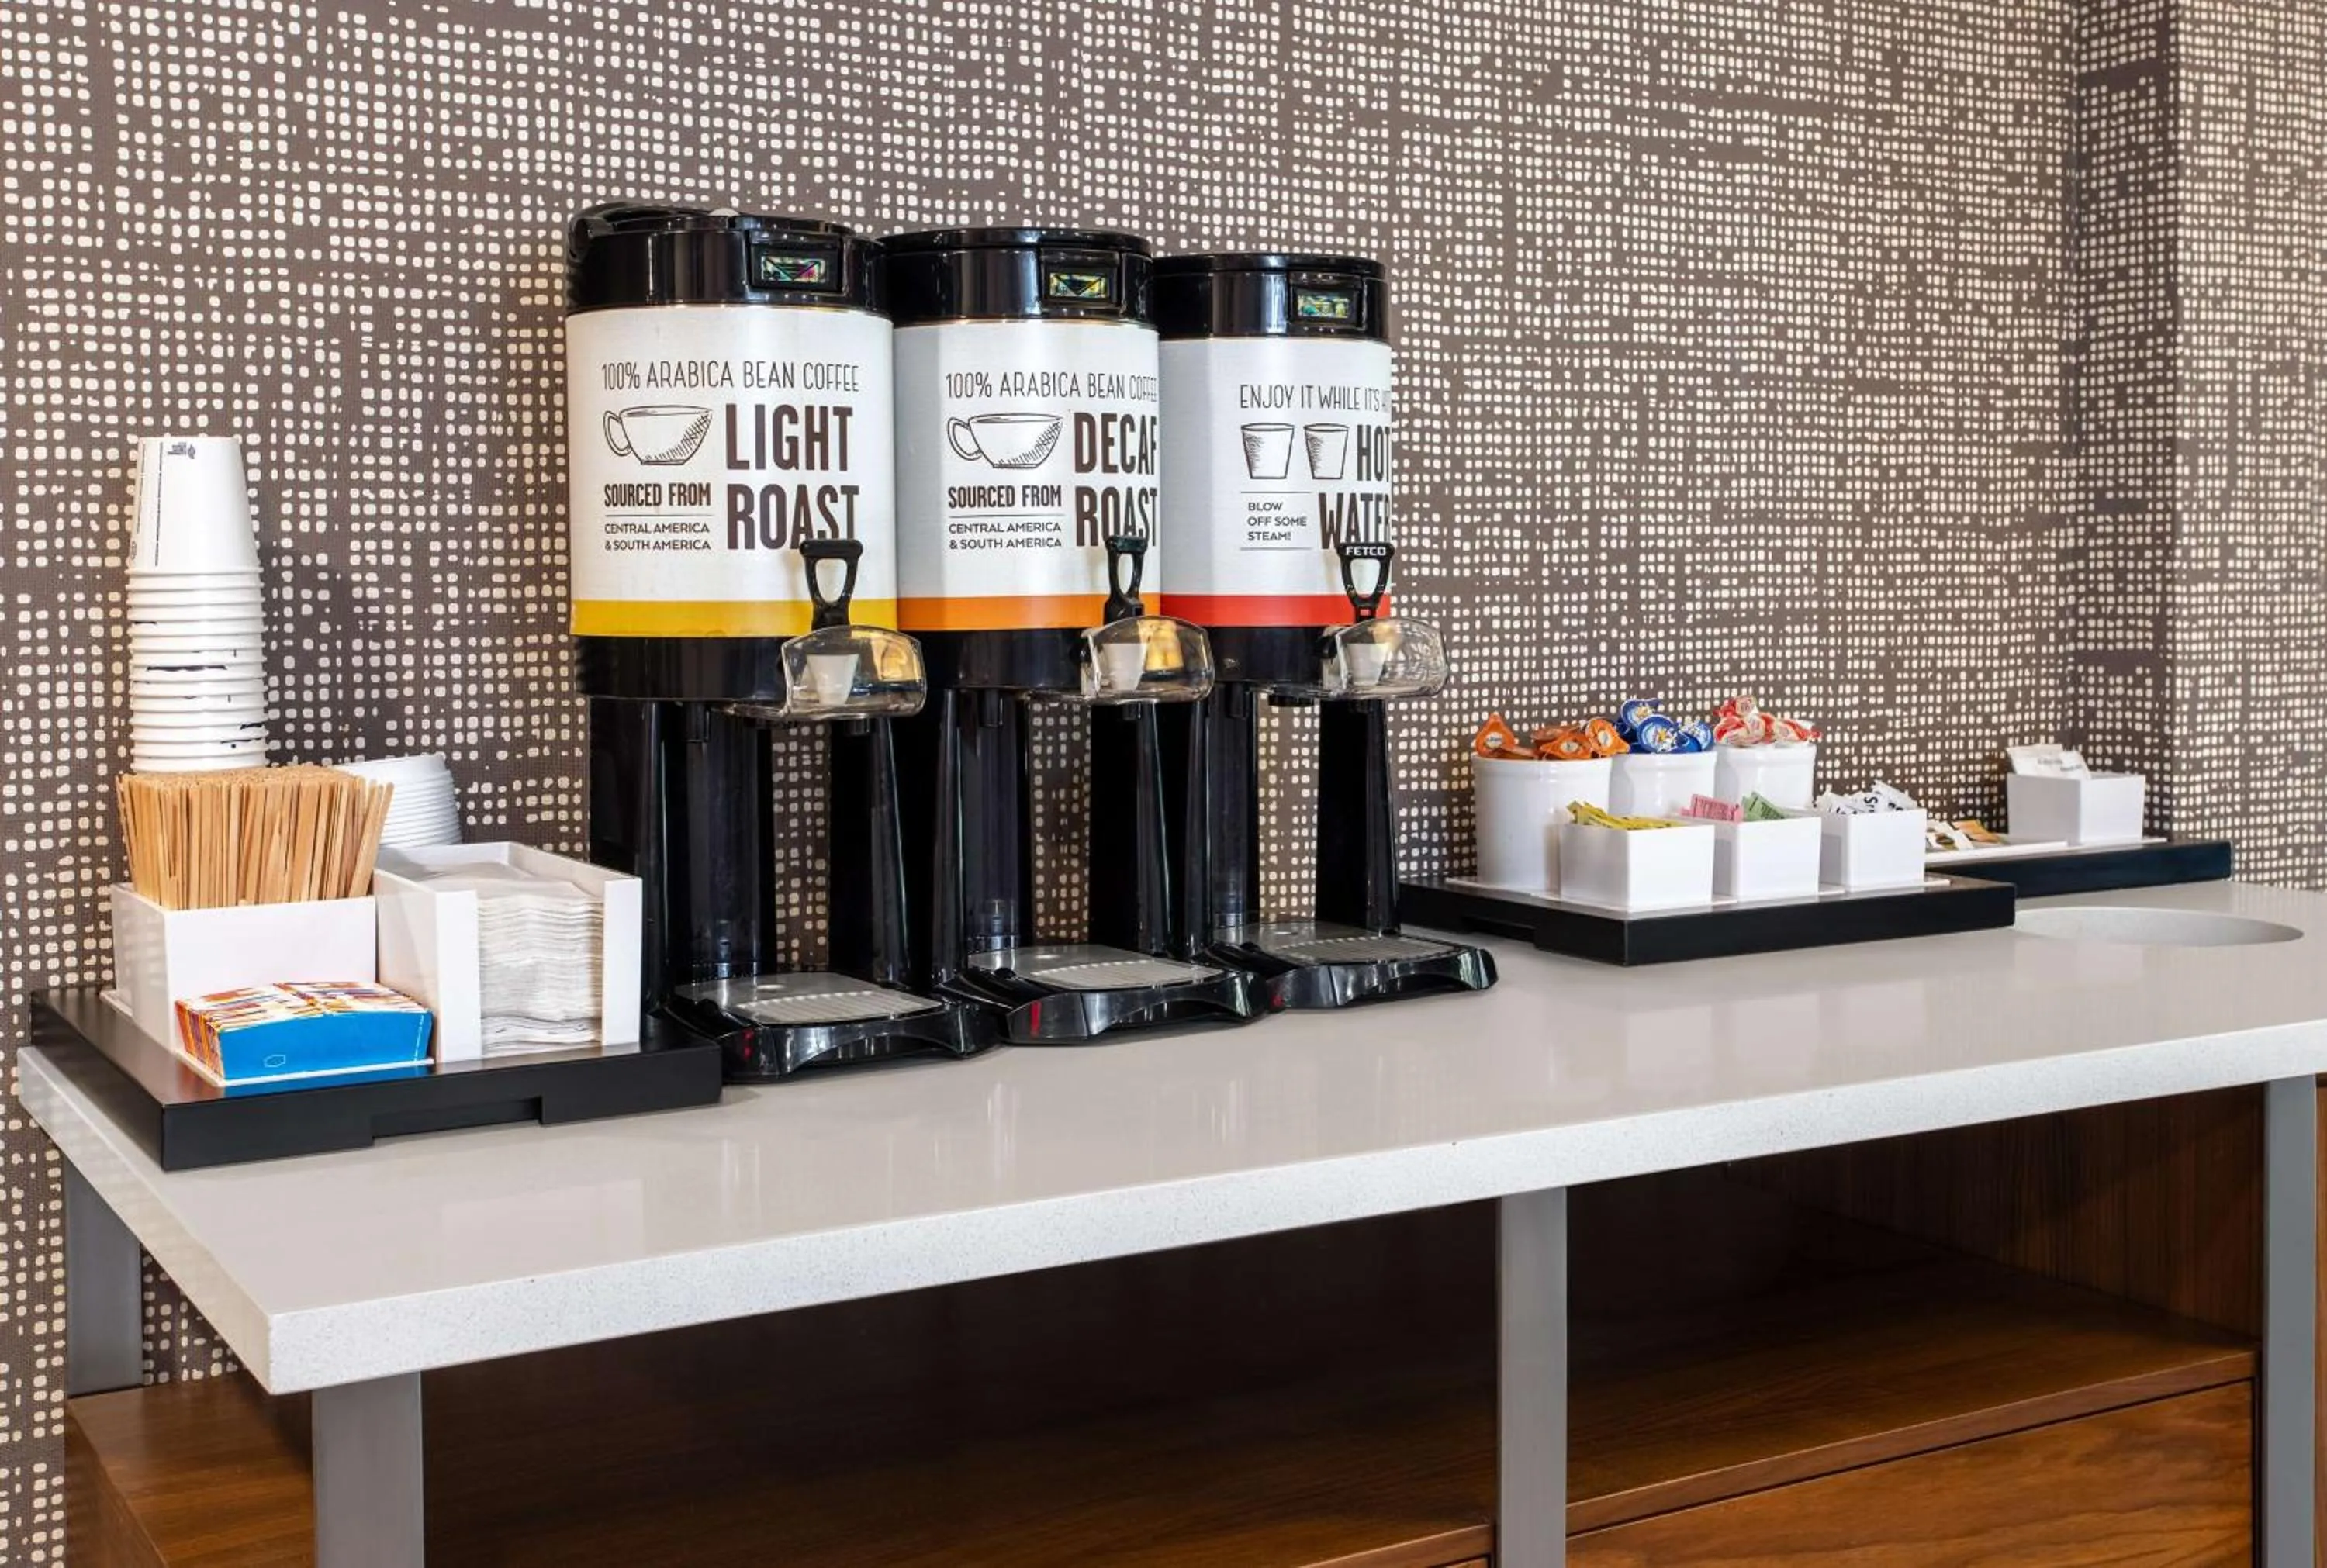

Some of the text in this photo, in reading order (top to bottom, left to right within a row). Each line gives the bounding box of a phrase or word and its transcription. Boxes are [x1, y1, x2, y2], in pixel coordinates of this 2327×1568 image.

[602, 361, 859, 392] 100% ARABICA BEAN COFFEE
[946, 372, 992, 398] 100%
[1000, 372, 1081, 397] ARABICA
[1088, 373, 1125, 399] BEAN
[1240, 385, 1294, 408] ENJOY
[1301, 385, 1313, 409] IT
[1318, 386, 1360, 410] WHILE
[726, 403, 852, 471] LIGHT
[1074, 413, 1157, 475] DECAF
[1357, 425, 1390, 482] HOT
[604, 482, 711, 507] SOURCED FROM
[948, 485, 1061, 509] SOURCED FROM
[728, 484, 859, 550] ROAST
[1075, 486, 1157, 546] ROAST
[1248, 503, 1282, 511] BLOW
[605, 523, 710, 534] CENTRAL AMERICA
[949, 522, 1061, 534] CENTRAL AMERICA
[1247, 516, 1306, 527] OFF SOME
[605, 540, 711, 551] & SOUTH AMERICA
[949, 537, 1061, 549] & SOUTH AMERICA
[1248, 531, 1291, 541] STEAM!
[1346, 547, 1386, 555] FETCO
